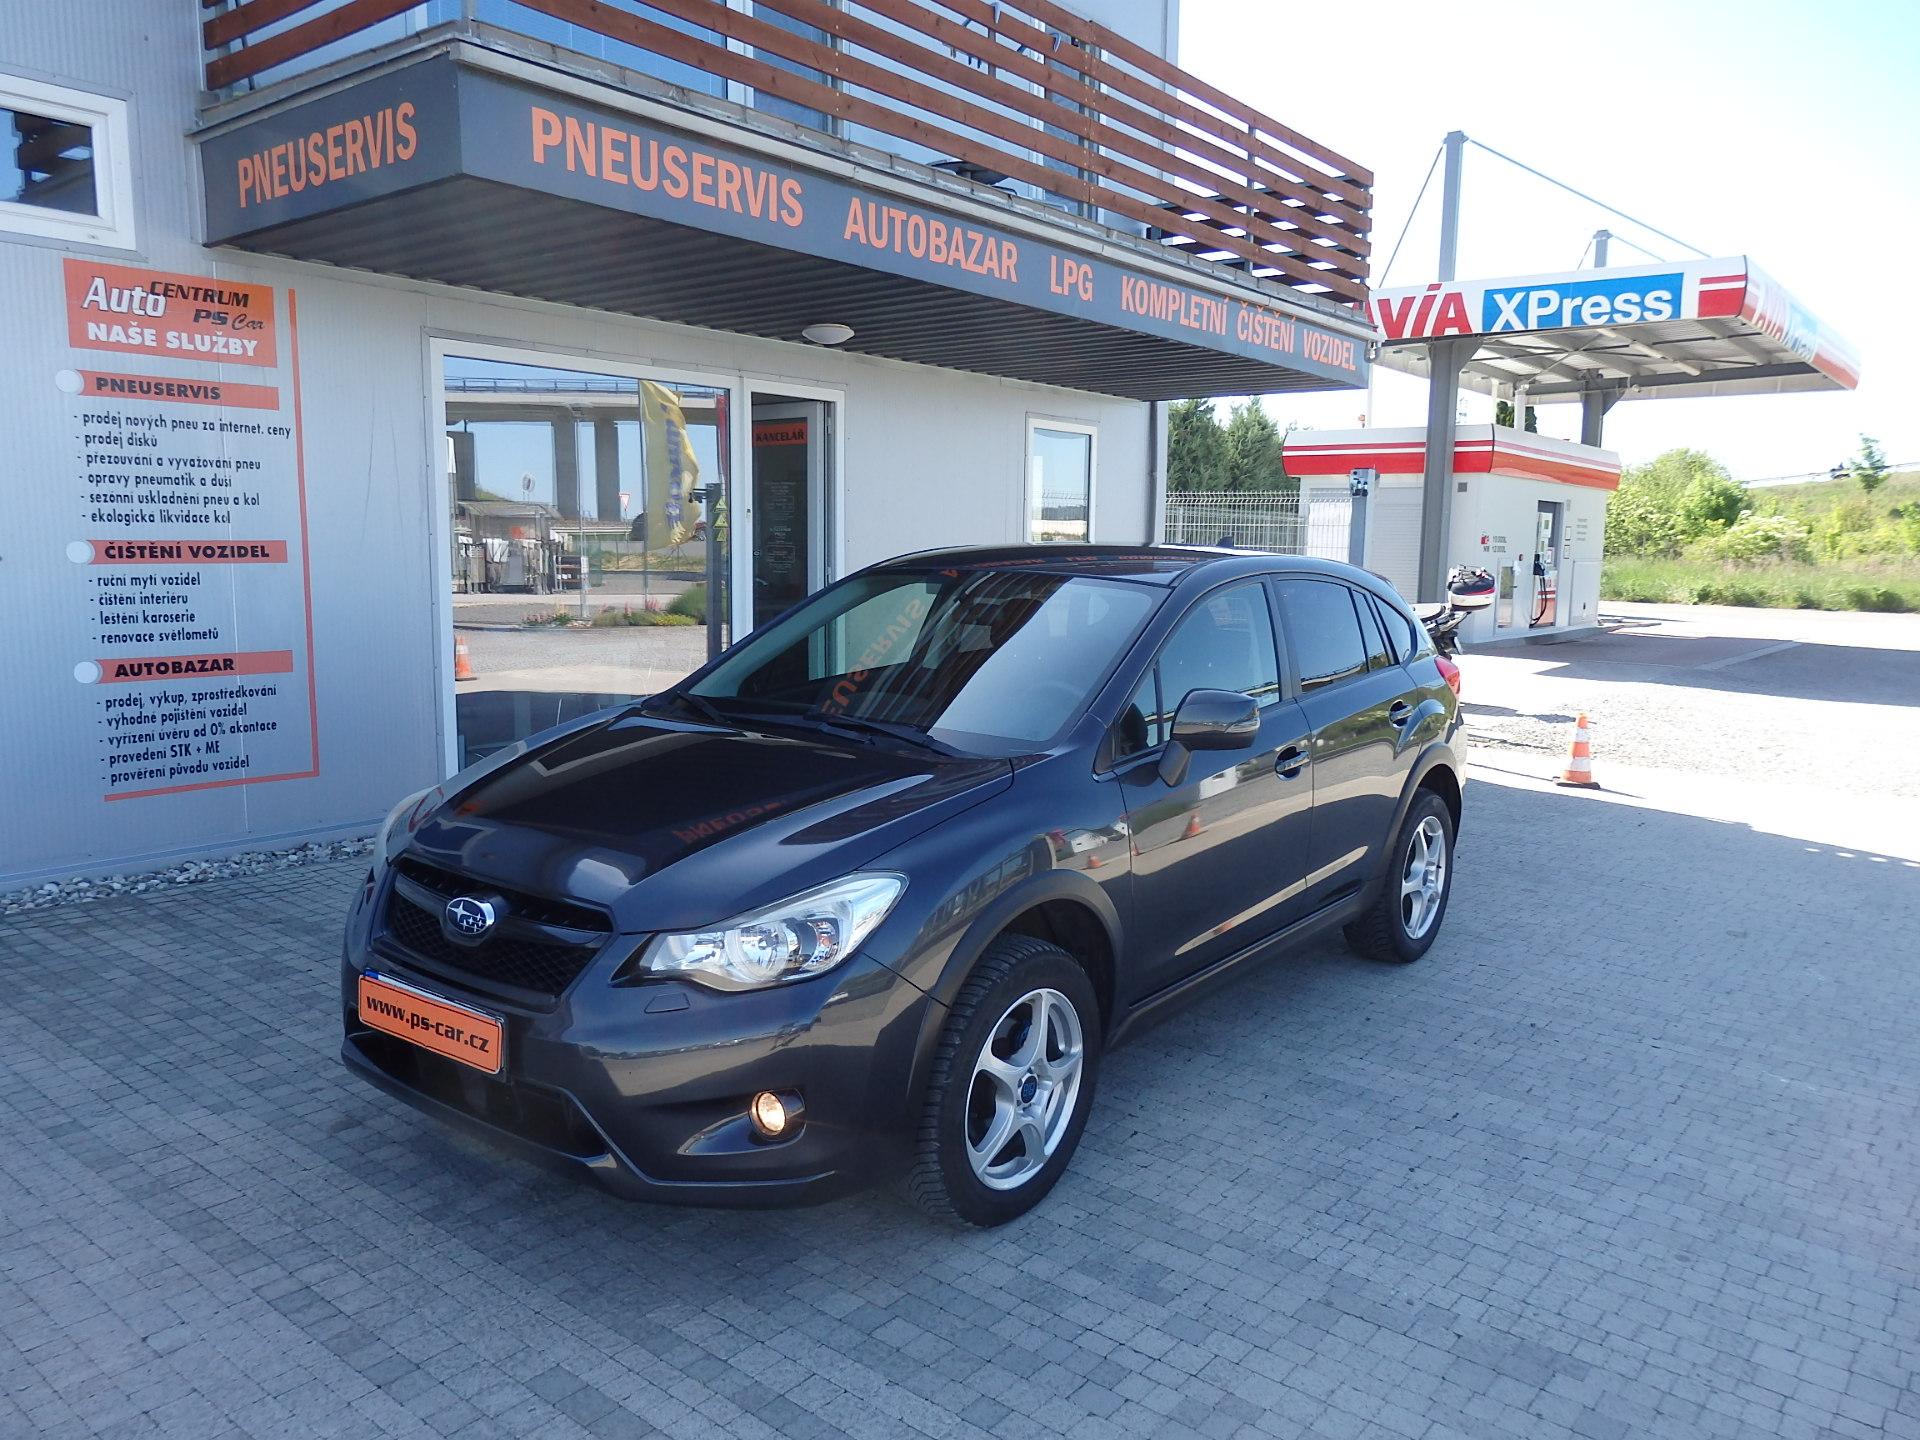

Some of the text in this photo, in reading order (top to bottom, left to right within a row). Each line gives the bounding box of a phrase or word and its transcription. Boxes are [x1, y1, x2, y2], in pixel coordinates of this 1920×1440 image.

[238, 101, 417, 208] PNEUSERVIS
[531, 106, 1357, 372] PNEUSERVIS AUTOBAZAR LPG KOMPLETNÍ ČIŠTĚNÍ VOZIDEL
[81, 276, 167, 317] Auto
[150, 281, 249, 308] CENTRUM
[192, 309, 265, 331] PS Car
[1352, 283, 1673, 339] VIA XPress
[87, 321, 258, 357] NAŠE SLUŽBY
[96, 377, 221, 400] PNEUSERVIS
[83, 411, 121, 429] prodej
[125, 414, 167, 431] nových
[171, 419, 198, 432] pneu
[202, 421, 215, 431] za
[267, 426, 291, 439] ceny
[84, 431, 158, 449] prodej disků
[86, 452, 152, 467] přezouvání
[157, 457, 163, 466] a
[236, 460, 260, 472] pneu
[88, 474, 130, 488] opravy
[135, 473, 196, 488] pneumatik
[200, 477, 207, 487] a
[203, 496, 229, 508] pneu
[233, 496, 240, 505] a
[243, 492, 260, 506] kol
[91, 508, 231, 526] ekologická likvidace kol
[104, 542, 269, 559] ČIŠTĚNÍ VOZIDEL
[97, 574, 127, 587] ruční
[161, 572, 201, 586] vozidel
[140, 591, 188, 605] interiéru
[142, 609, 195, 623] karoserie
[101, 627, 219, 644] renovace světlometů
[114, 658, 235, 678] AUTOBAZAR
[149, 690, 188, 708] výkup,
[191, 684, 277, 704] zprostředkování
[107, 711, 157, 730] výhodné
[210, 702, 247, 718] vozidel
[193, 724, 207, 737] od
[210, 722, 226, 736] 0%
[229, 721, 277, 734] akontace
[109, 747, 167, 768] provedení
[170, 743, 192, 758] STK
[205, 740, 220, 755] ME
[110, 754, 250, 786] prověření původu vozidel
[366, 996, 490, 1053] www.ps-car.cz
